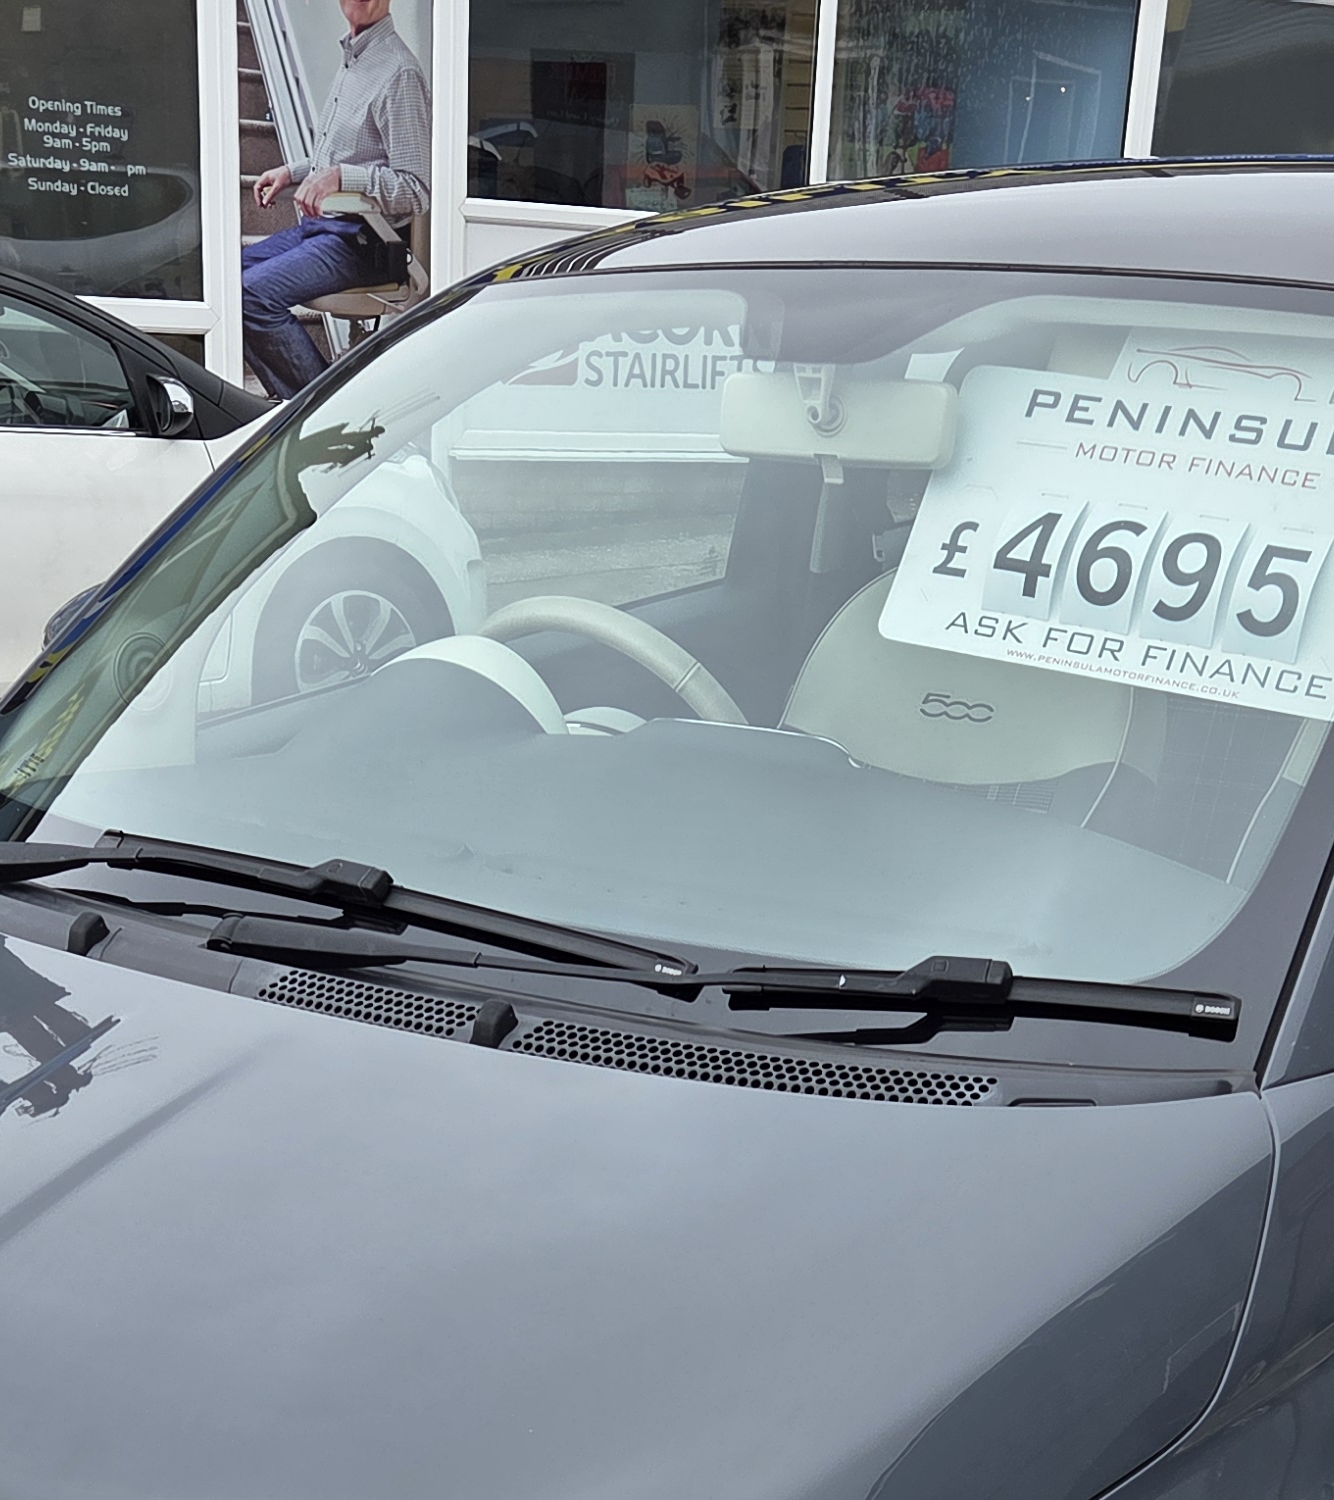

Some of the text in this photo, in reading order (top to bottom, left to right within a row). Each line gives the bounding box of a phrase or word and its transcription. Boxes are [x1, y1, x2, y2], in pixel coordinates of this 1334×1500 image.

[28, 96, 122, 117] Opening Times
[24, 118, 77, 137] Monday
[86, 123, 129, 141] Friday
[43, 135, 73, 150] 9am
[82, 137, 111, 154] 5pm
[8, 153, 71, 172] Saturday
[79, 158, 109, 173] 9am
[126, 164, 147, 177] pm
[28, 177, 78, 196] Sunday
[87, 181, 129, 197] Closed
[584, 350, 772, 390] STAIRLIFT
[1075, 442, 1322, 491] MOTOR FINANCE
[945, 611, 1334, 700] ASK FOR FINANCE
[1006, 648, 1241, 700] WWW.PENINSULAMOTORFINANCE.CO.UK
